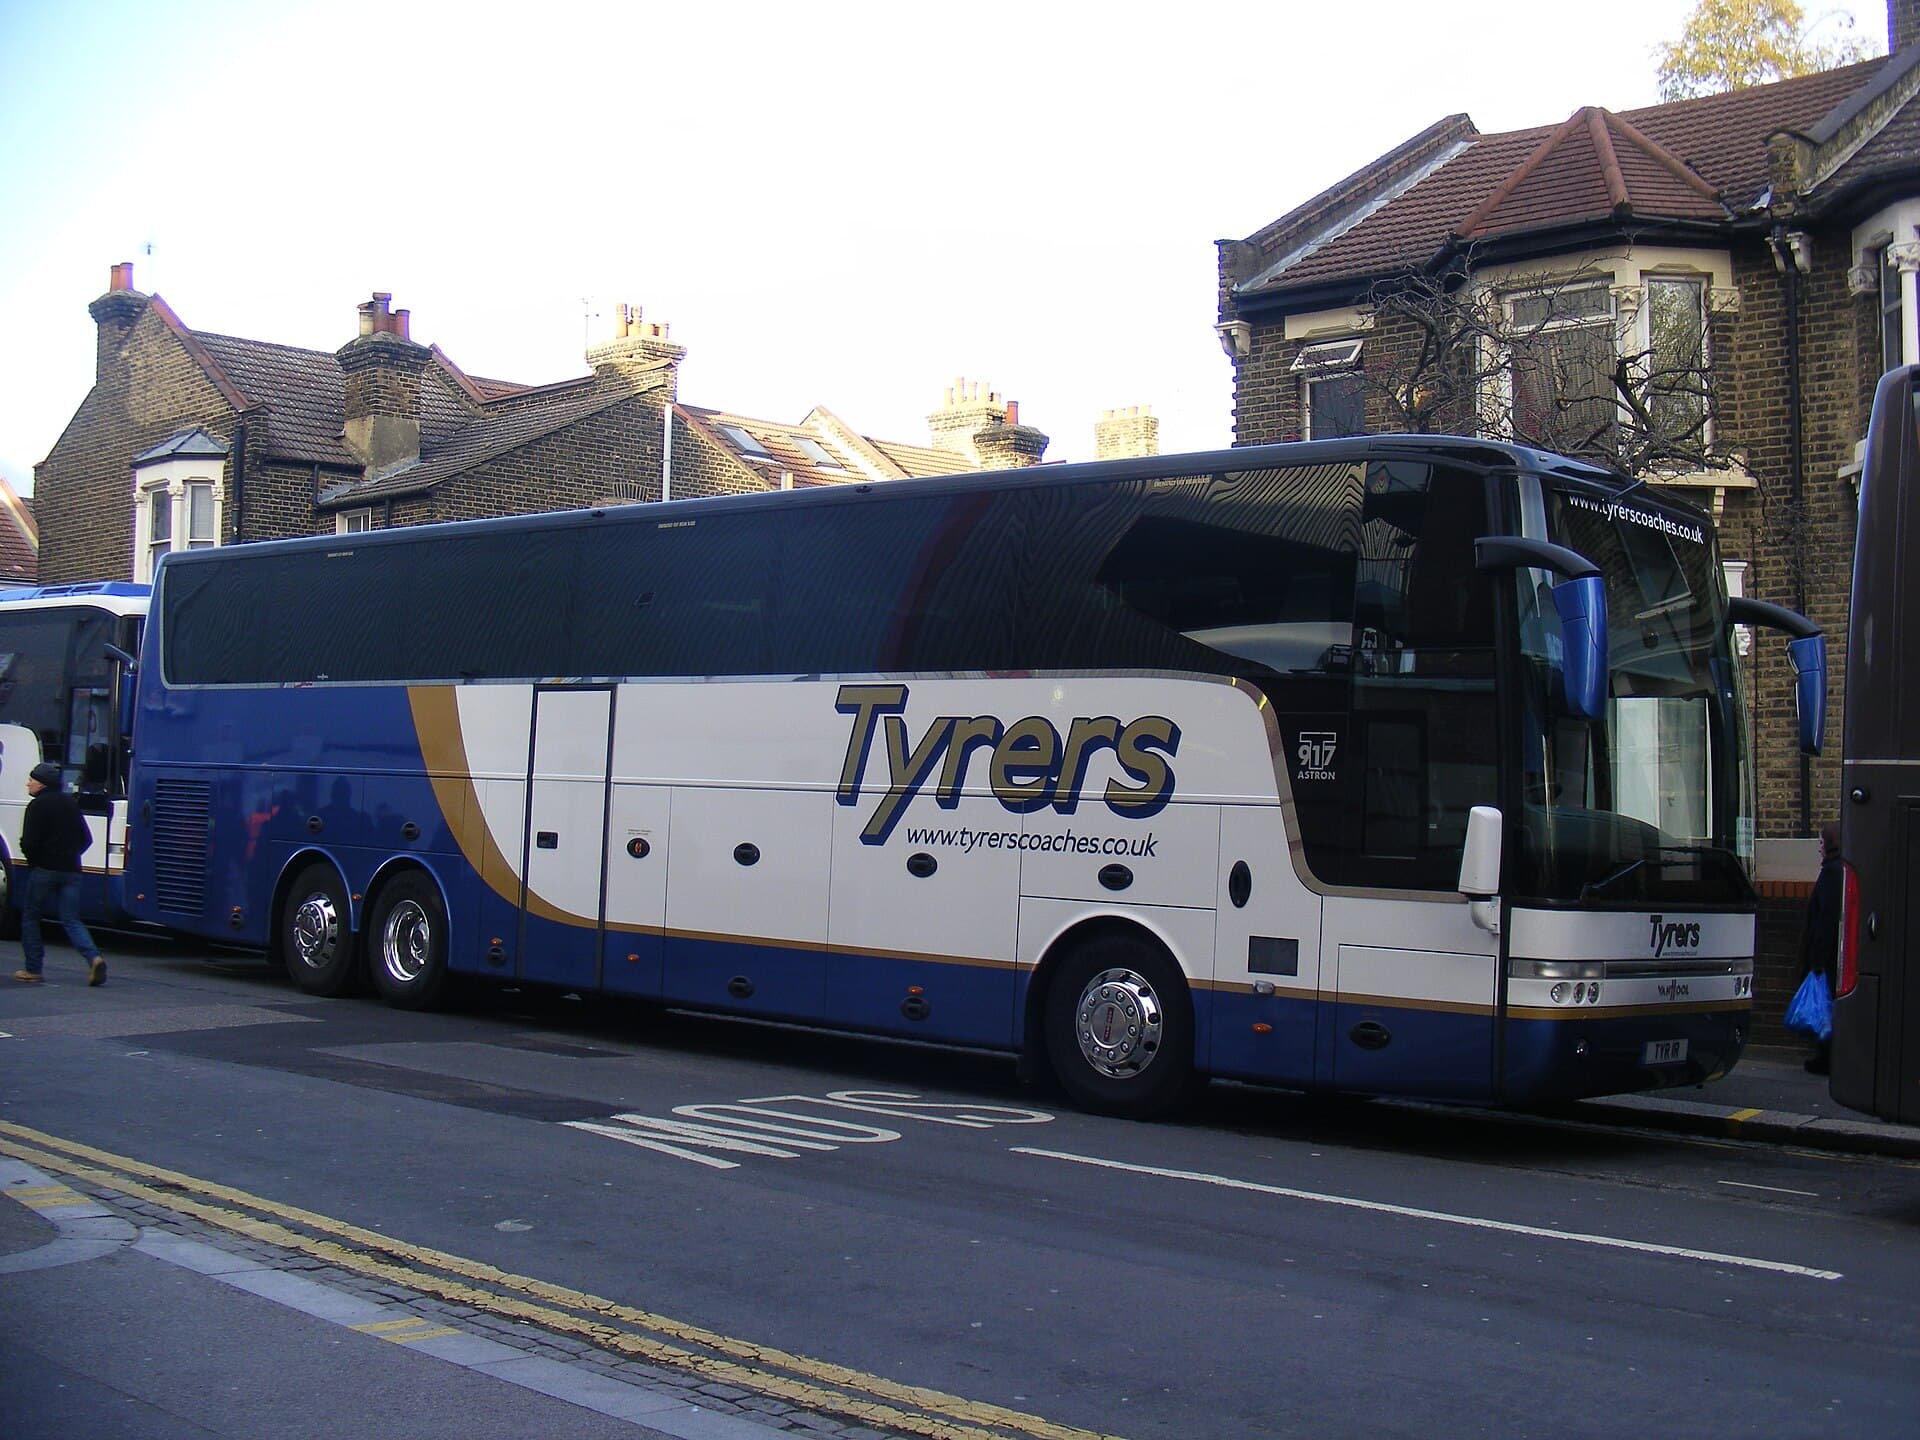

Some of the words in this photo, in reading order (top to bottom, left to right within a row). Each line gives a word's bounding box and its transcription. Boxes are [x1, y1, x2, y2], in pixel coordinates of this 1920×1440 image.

[1569, 495, 1704, 545] www.tyrerscoaches.co.uk
[834, 683, 1182, 846] Tyrers
[1297, 770, 1336, 780] ASTRON
[906, 826, 1159, 858] www.tyrerscoaches.co.uk
[1650, 914, 1700, 958] Tyrers
